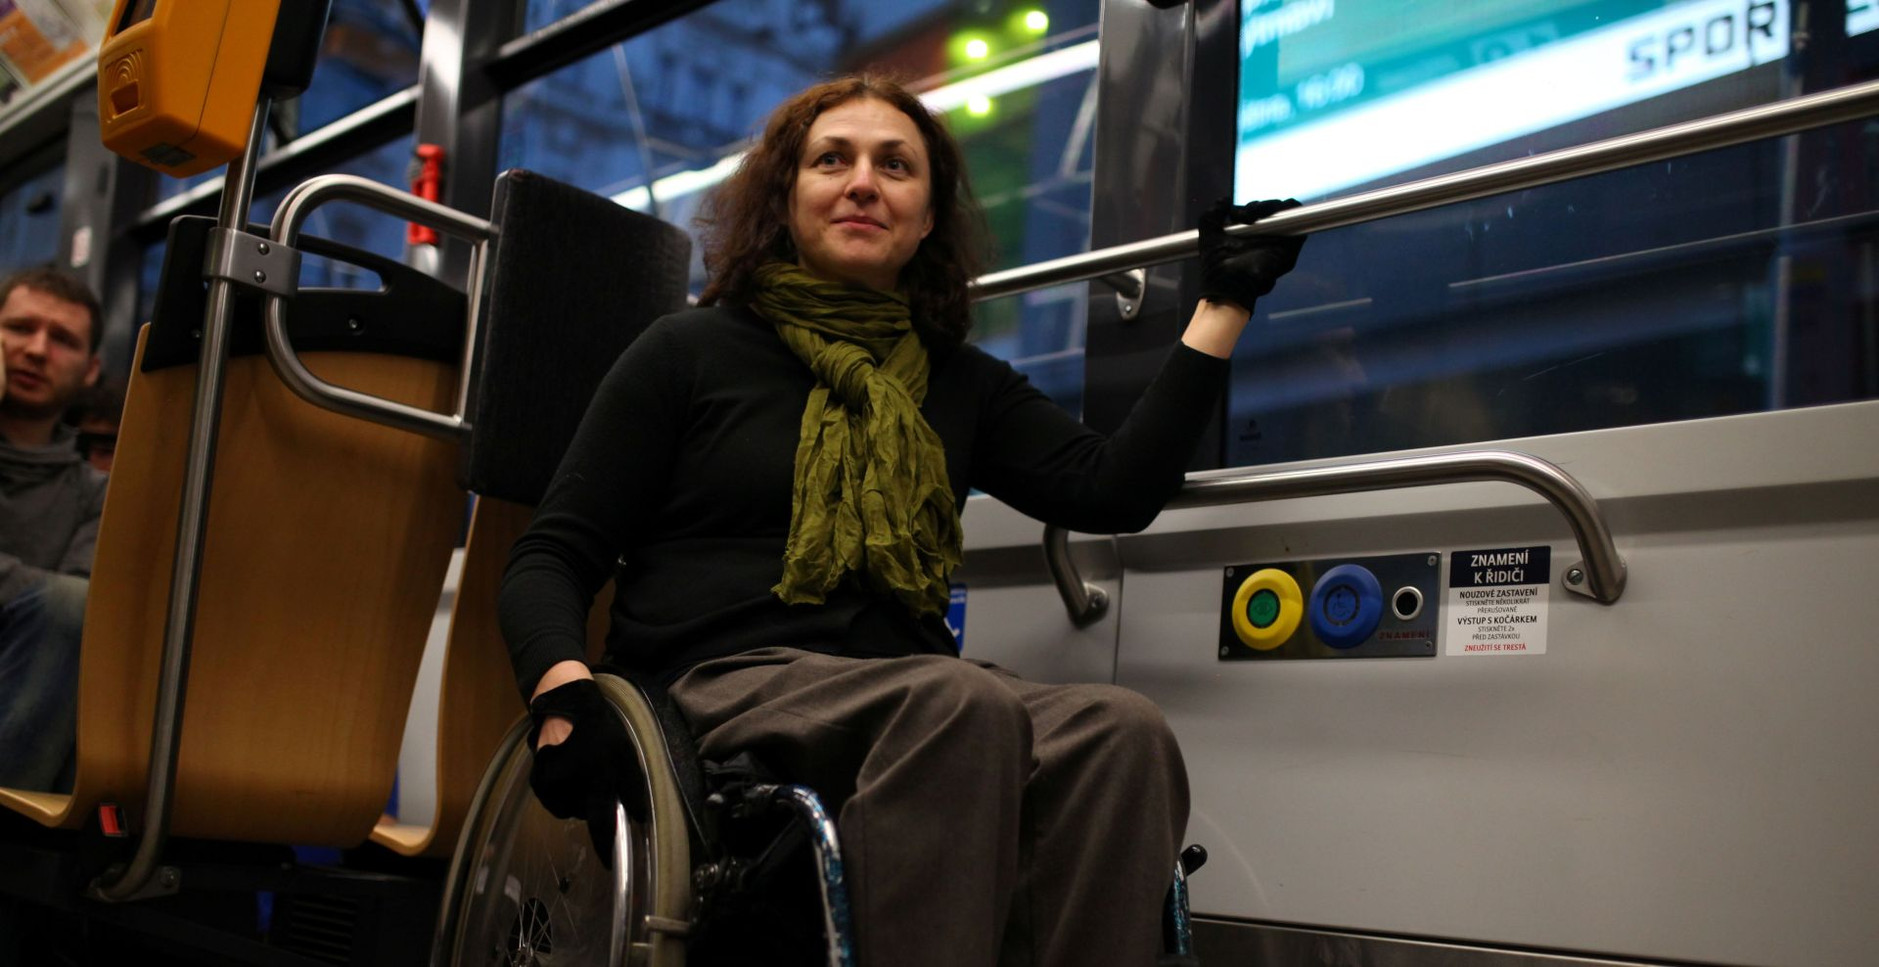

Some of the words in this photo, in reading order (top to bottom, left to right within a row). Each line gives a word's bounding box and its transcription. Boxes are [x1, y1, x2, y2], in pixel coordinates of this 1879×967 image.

[1471, 549, 1529, 567] ZNAMENÍ
[1474, 571, 1482, 584] K
[1486, 567, 1524, 584] ŘIDIČI
[1459, 589, 1495, 599] NOUZOVÉ
[1496, 587, 1538, 597] ZASTAVENÍ
[1496, 597, 1530, 605] NĚKOLIKRÁT
[1458, 616, 1486, 625] VÝSTUP
[1494, 614, 1538, 624] KOČÁRKEM
[1487, 632, 1520, 640] ZASTÁVKOU
[1464, 643, 1492, 652] ZNEUŽITÍ
[1503, 642, 1527, 650] TRESTÁ
